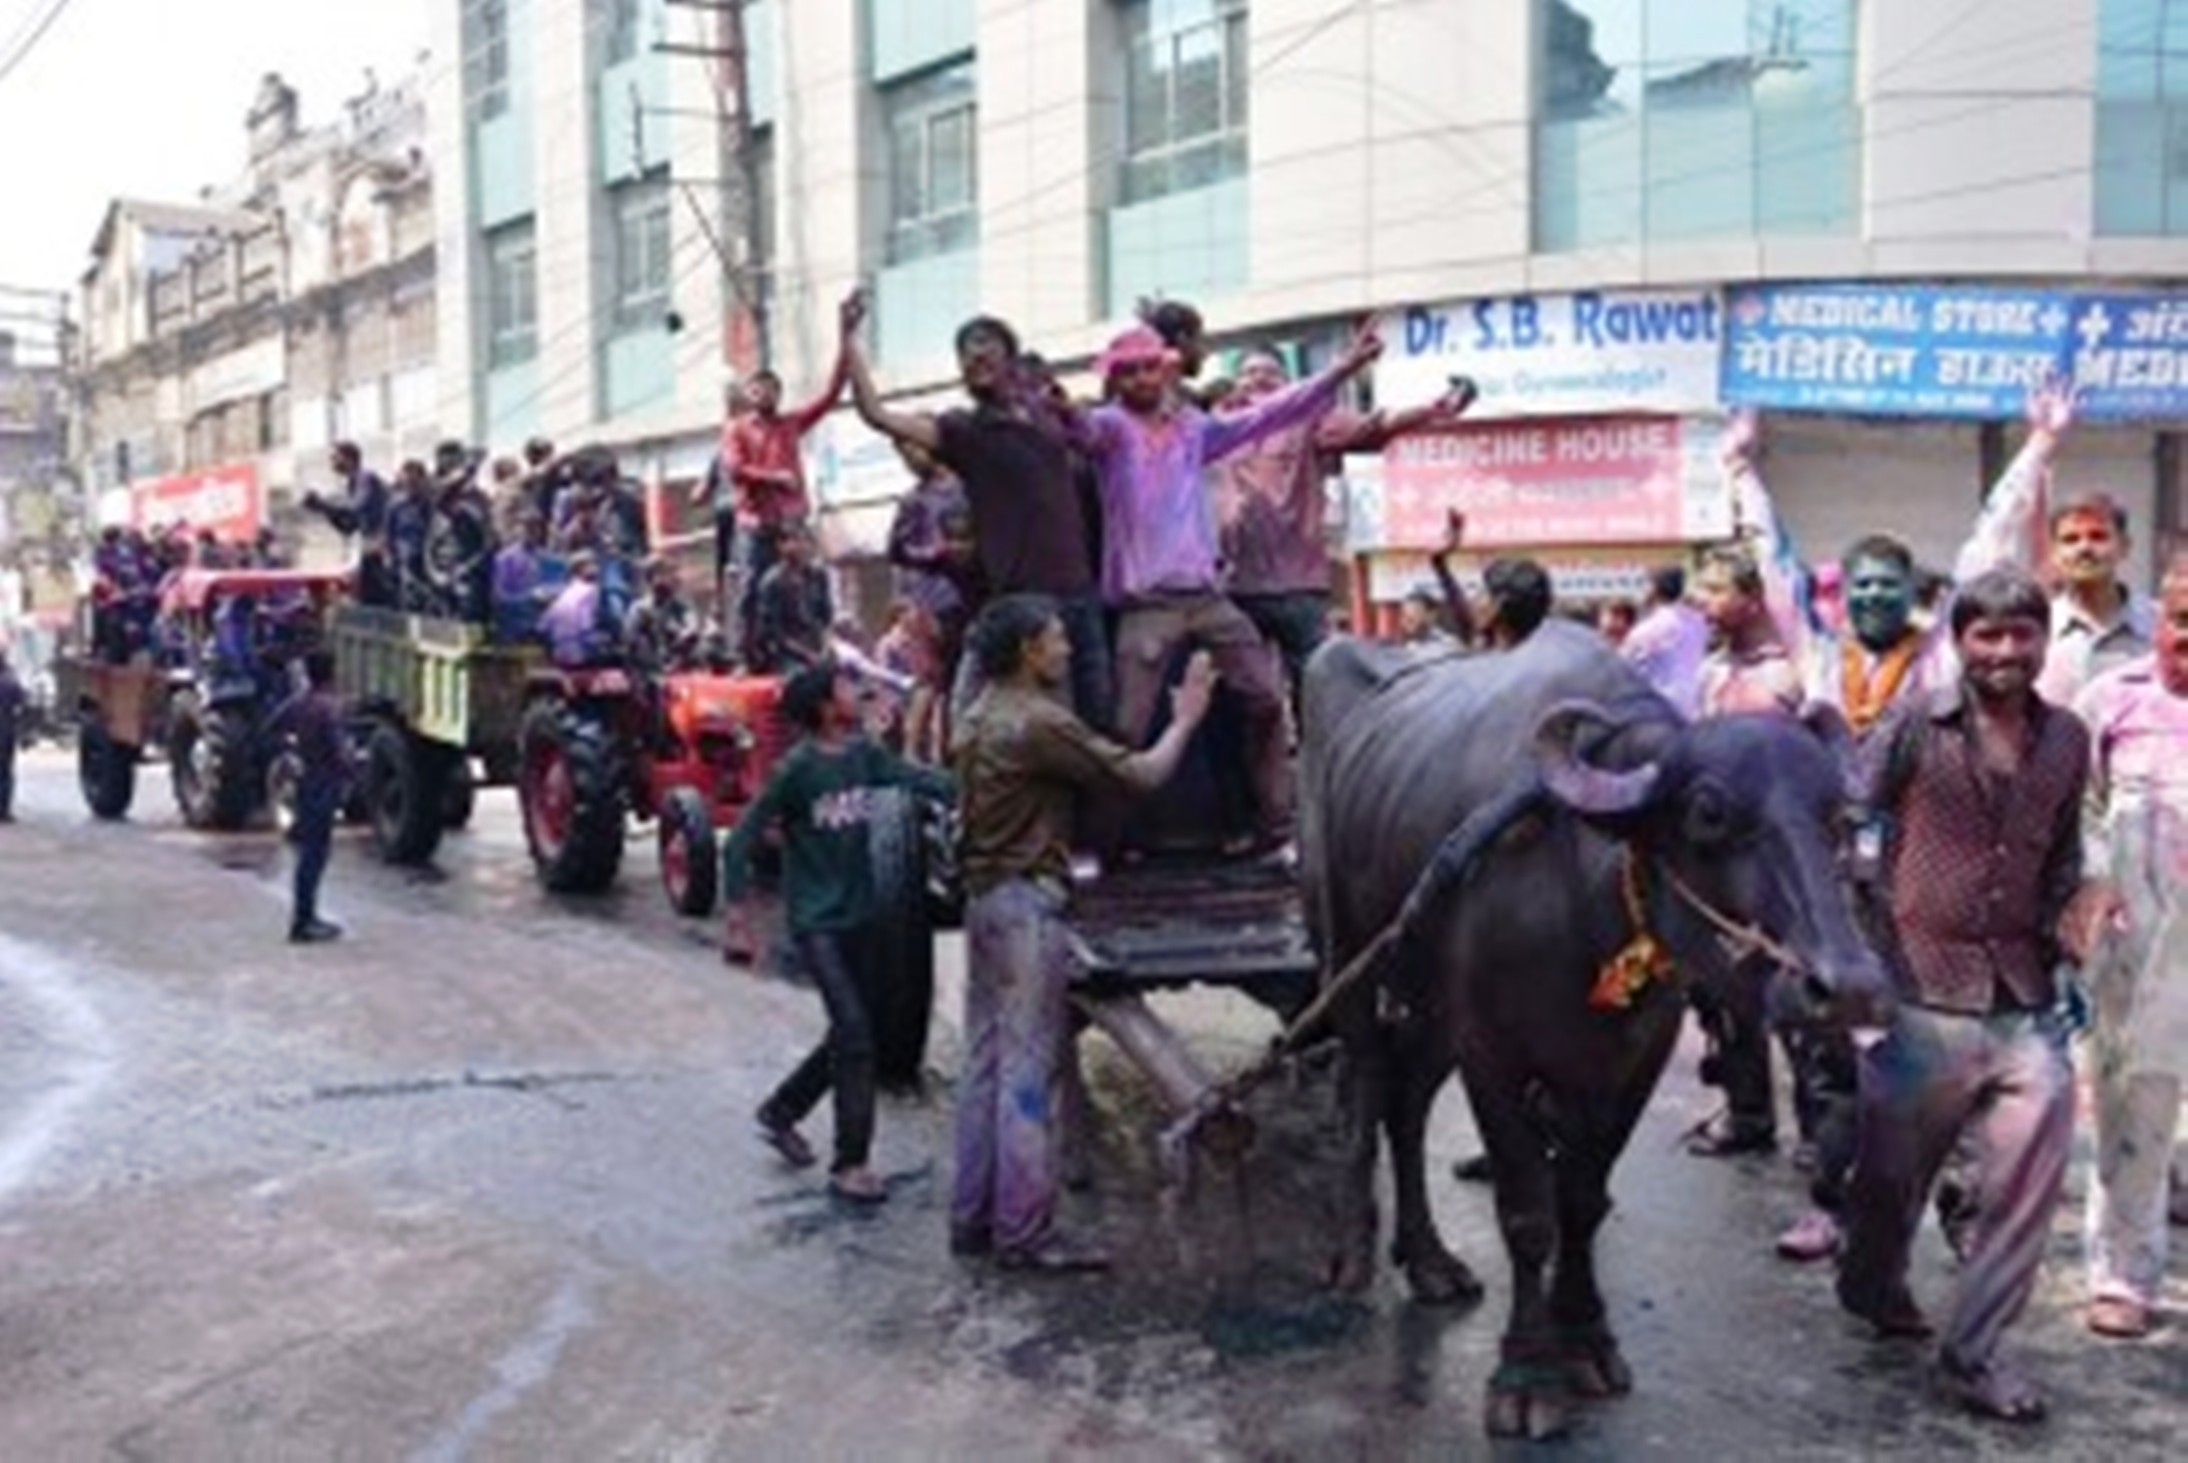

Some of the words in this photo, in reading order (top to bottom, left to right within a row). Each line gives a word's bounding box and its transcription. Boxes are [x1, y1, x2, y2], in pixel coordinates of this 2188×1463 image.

[1405, 305, 1459, 356] Dr.
[1474, 296, 1556, 350] S.B.
[1574, 290, 1717, 347] Rawat
[1770, 295, 1920, 335] MEDICAL
[1932, 300, 2036, 336] STORE
[1402, 431, 1549, 469] MEDICINE
[1558, 427, 1668, 462] HOUSE
